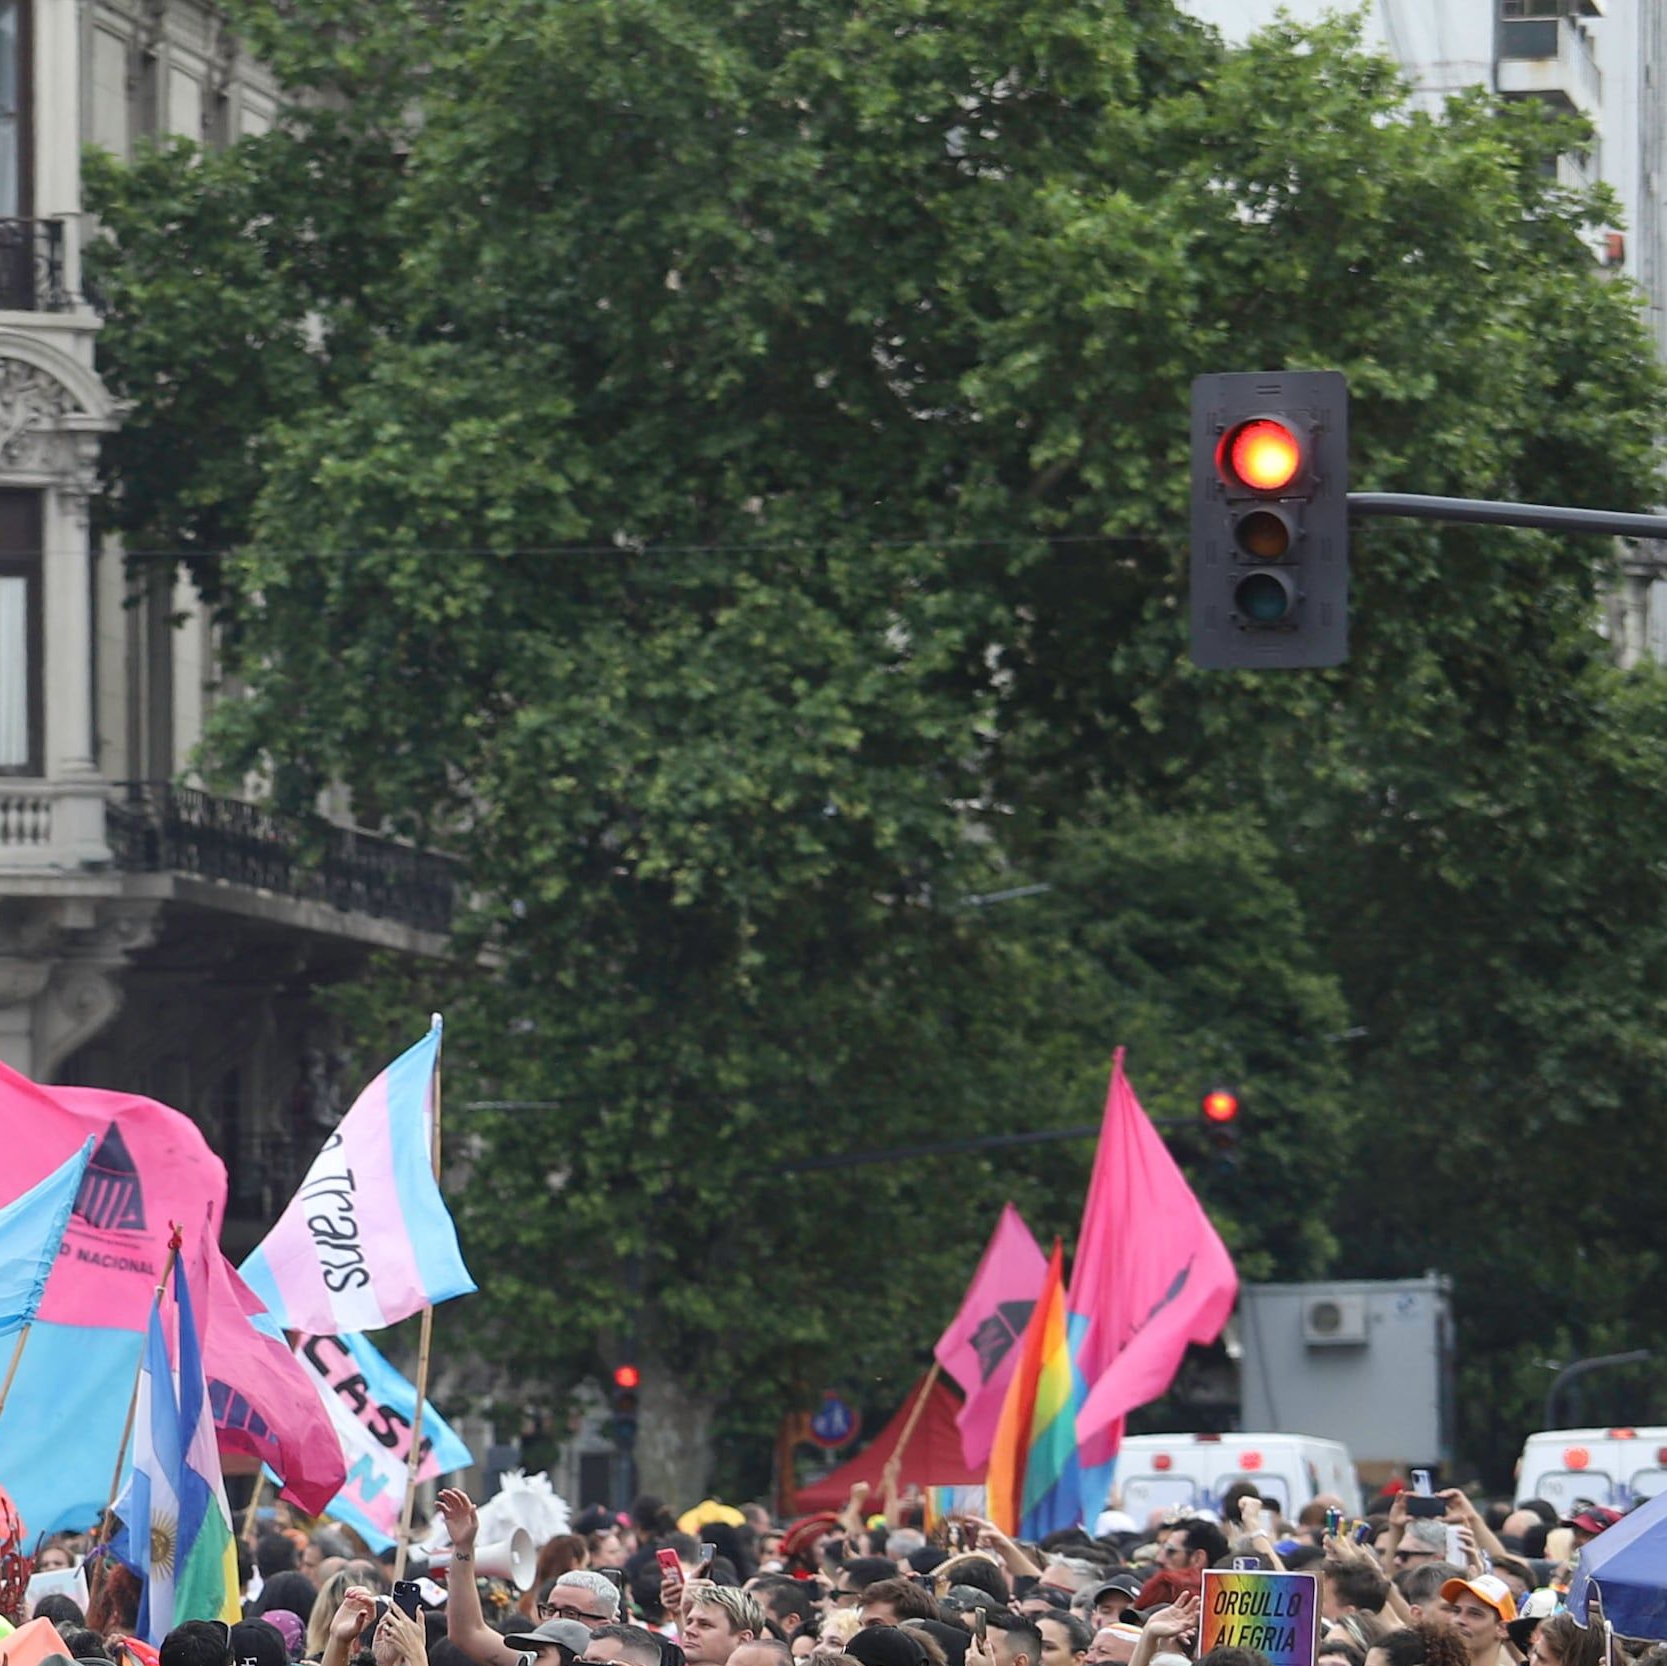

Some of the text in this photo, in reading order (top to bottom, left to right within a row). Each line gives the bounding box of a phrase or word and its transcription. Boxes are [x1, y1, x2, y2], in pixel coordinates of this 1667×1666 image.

[301, 1168, 371, 1292] Trans
[77, 1248, 155, 1275] NACIONAL
[1213, 1590, 1303, 1618] ORGULLO
